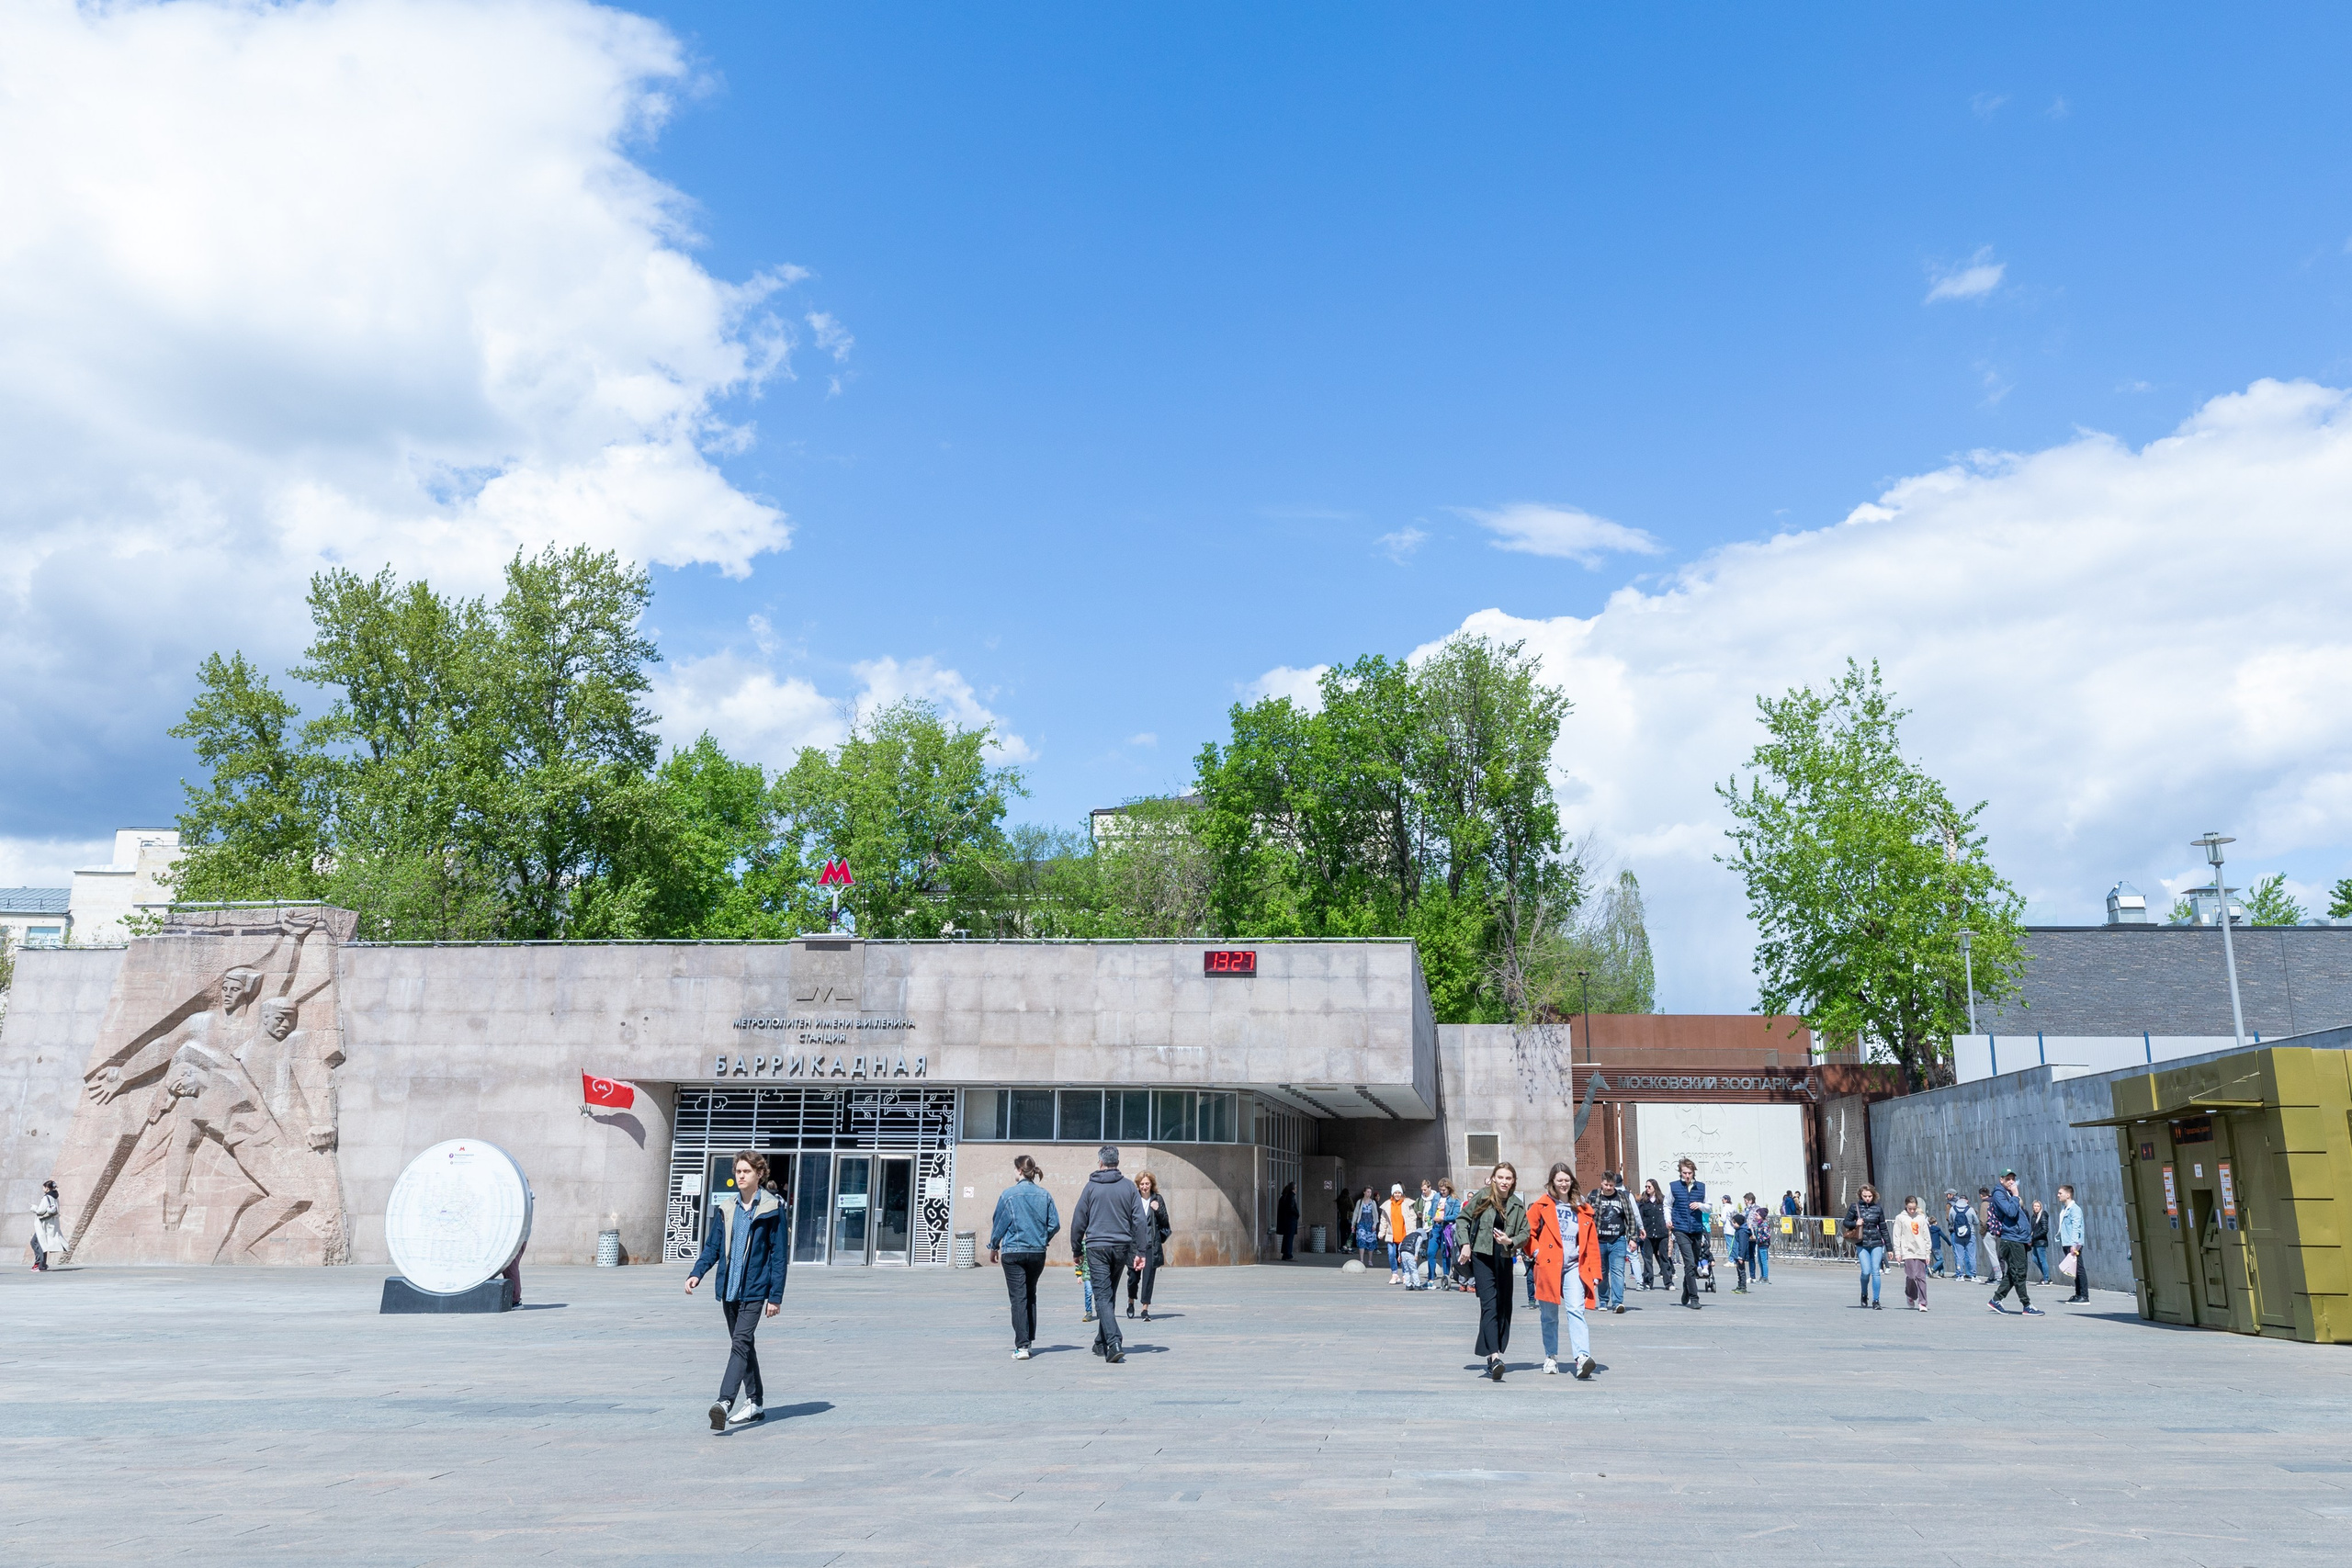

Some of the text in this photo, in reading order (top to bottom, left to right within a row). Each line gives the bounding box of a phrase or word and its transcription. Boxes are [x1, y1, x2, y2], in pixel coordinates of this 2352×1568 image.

[817, 857, 855, 885] М
[733, 1018, 811, 1029] МЕТРОПОЛИТЕН
[815, 1019, 854, 1029] ИМЕНИ
[799, 1032, 846, 1045] СТАНЦИЯ
[715, 1055, 927, 1077] БАРРИКАДНАЯ
[1617, 1077, 1791, 1090] МОСКОВСКИЙ ЗООПАРК
[1659, 1160, 1748, 1175] ЗОПАРК
[1556, 1209, 1578, 1224] YPD
